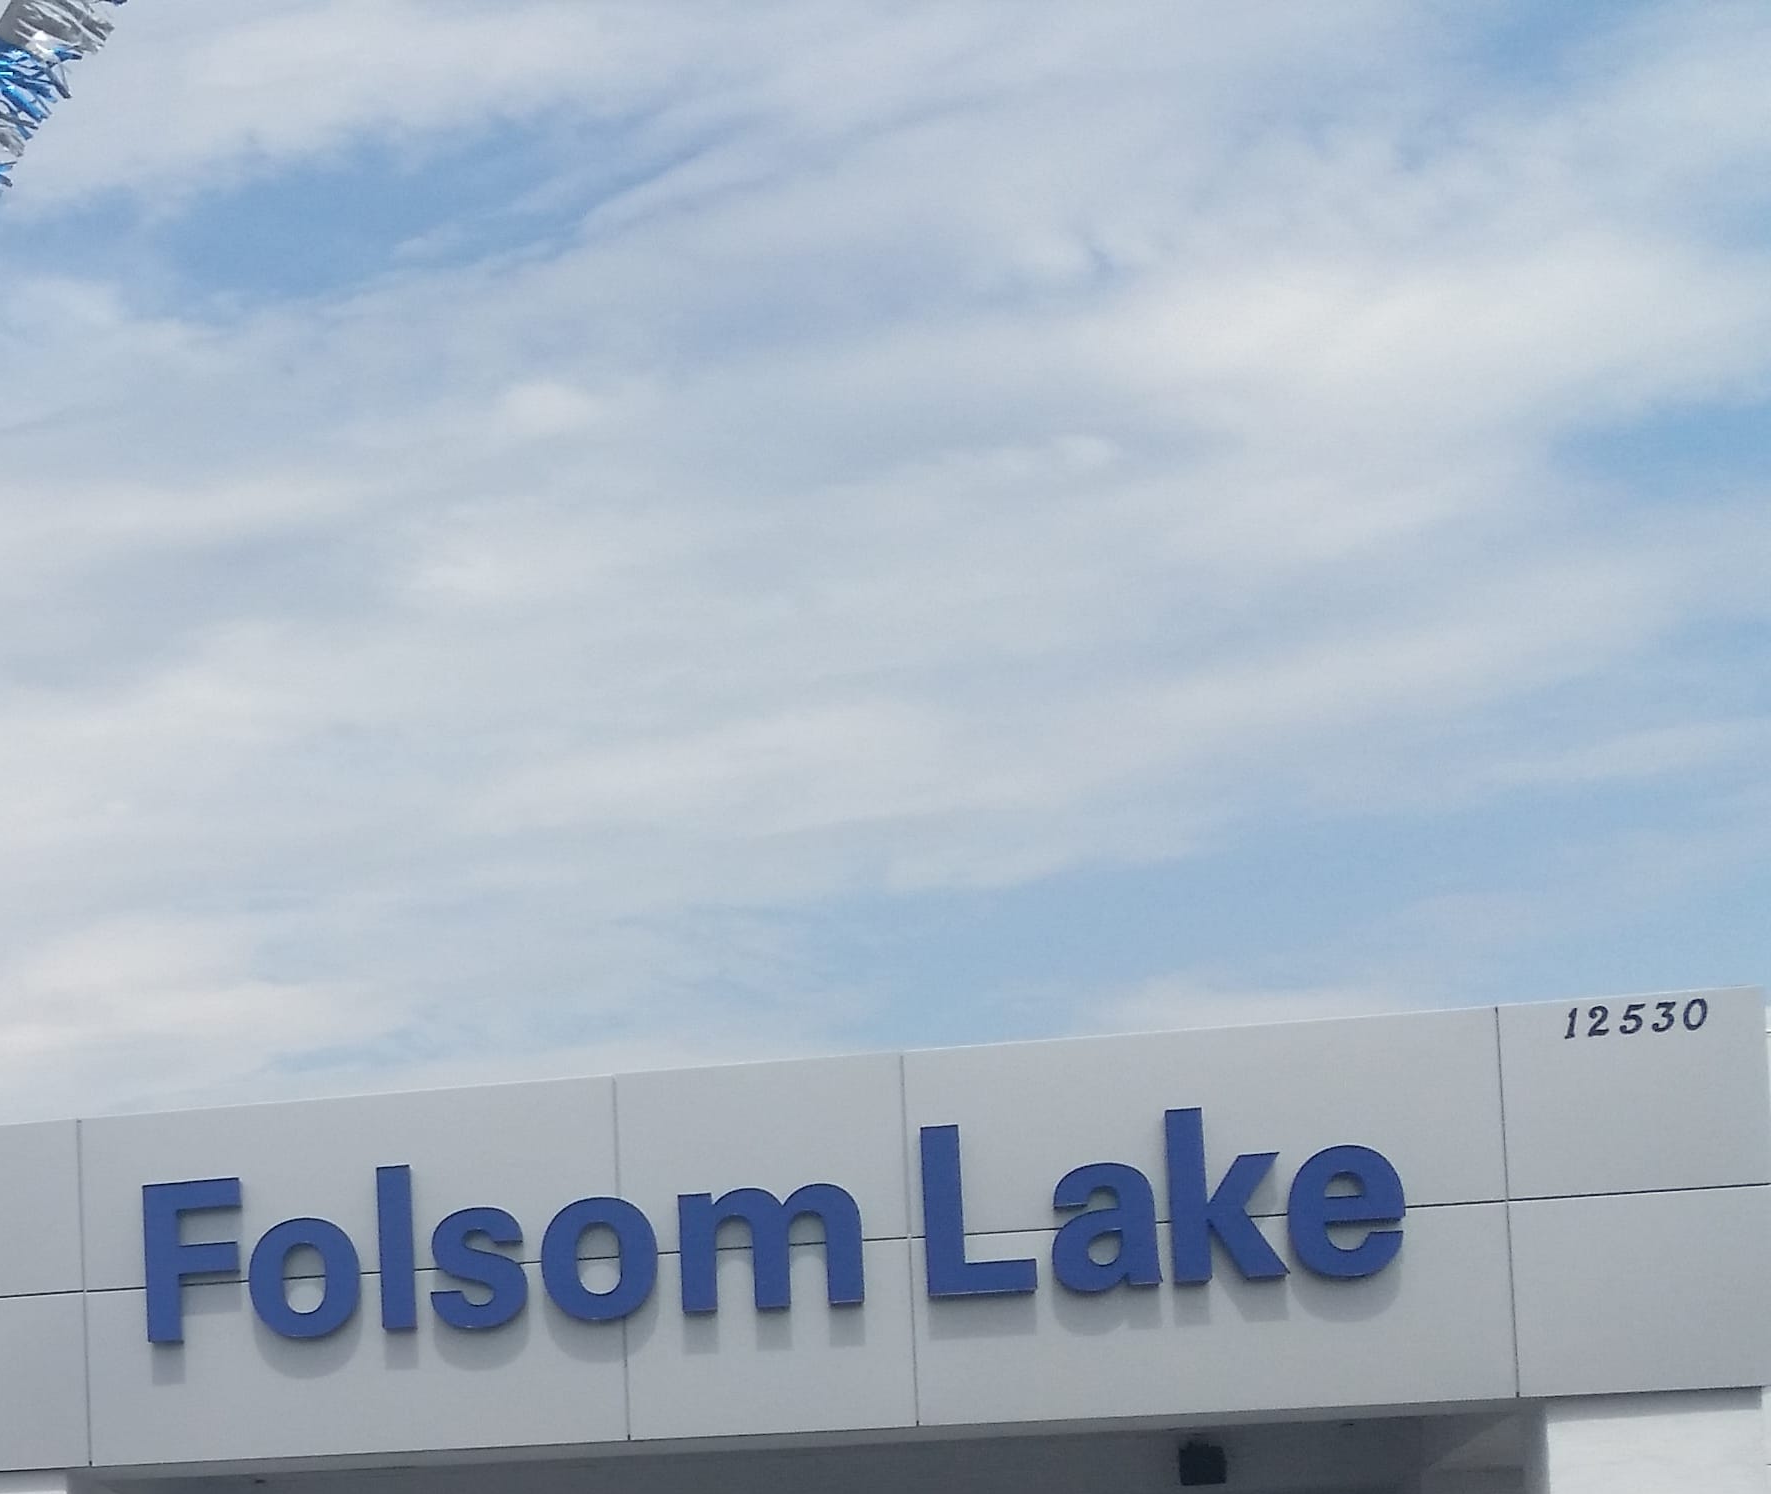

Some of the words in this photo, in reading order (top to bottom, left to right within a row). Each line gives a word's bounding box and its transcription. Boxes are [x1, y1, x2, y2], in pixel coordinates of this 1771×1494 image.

[1563, 998, 1708, 1039] 12530
[142, 1164, 865, 1345] Folsom
[920, 1107, 1406, 1302] Lake
